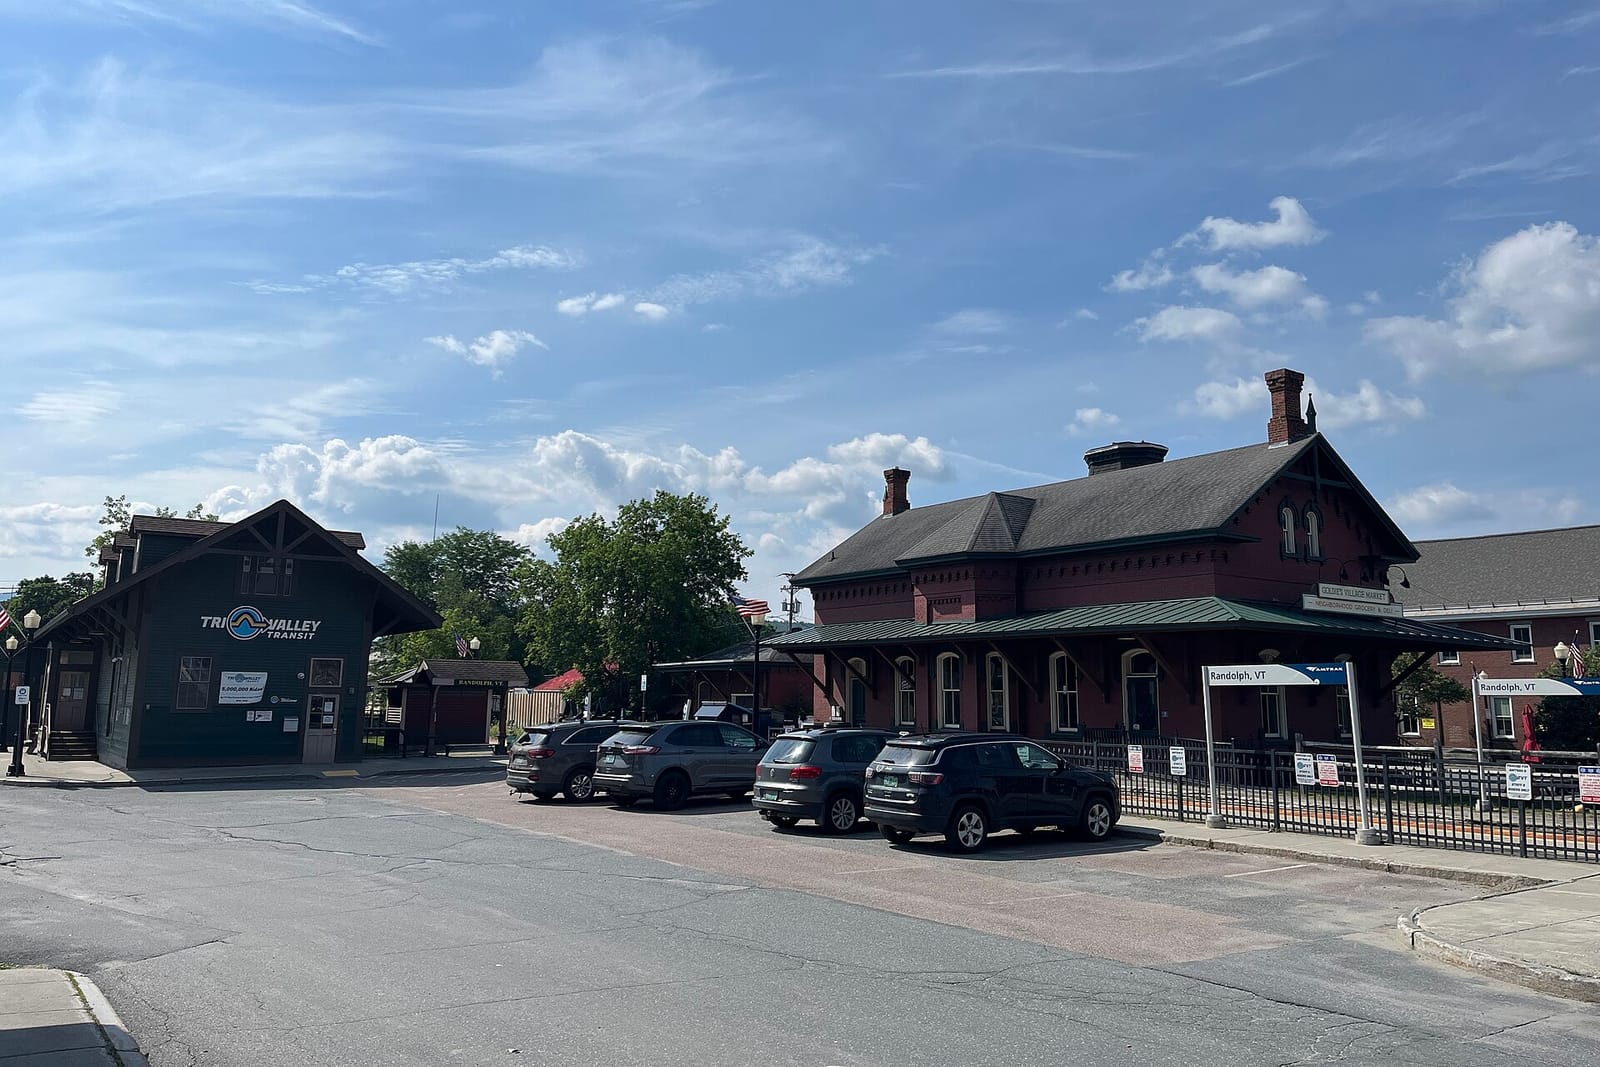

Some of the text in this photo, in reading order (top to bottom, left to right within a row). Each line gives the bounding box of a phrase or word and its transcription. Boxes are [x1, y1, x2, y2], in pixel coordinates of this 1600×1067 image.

[200, 616, 321, 631] TRI VALLEY
[267, 631, 316, 640] TRANSIT
[1211, 671, 1266, 681] Randolph, VT
[1480, 683, 1522, 692] Randolph,
